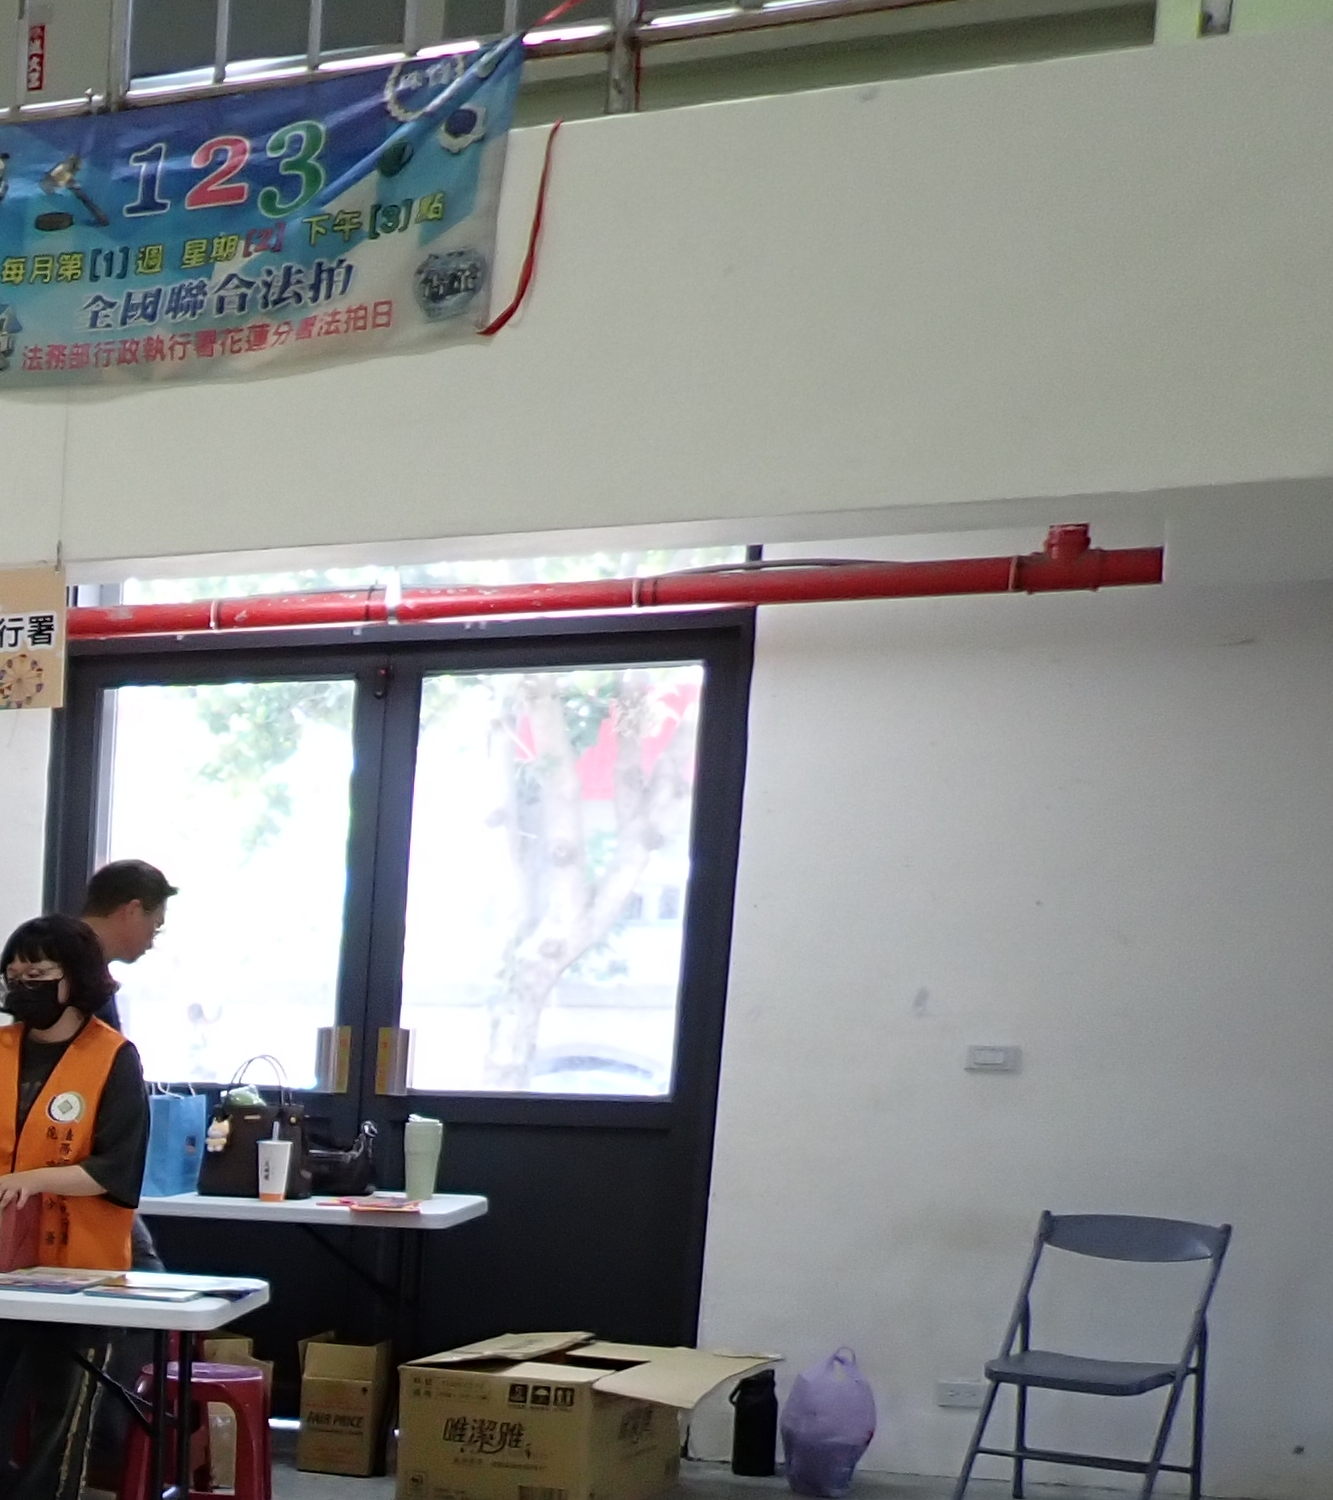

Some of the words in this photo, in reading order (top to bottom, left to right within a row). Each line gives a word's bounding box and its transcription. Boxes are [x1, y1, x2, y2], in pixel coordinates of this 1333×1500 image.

[123, 118, 327, 218] 123
[76, 258, 355, 331] 全國聯合法拍
[22, 300, 393, 372] 法務部行政執行署花蓮分署法拍日
[443, 1416, 525, 1453] 唯潔雅
